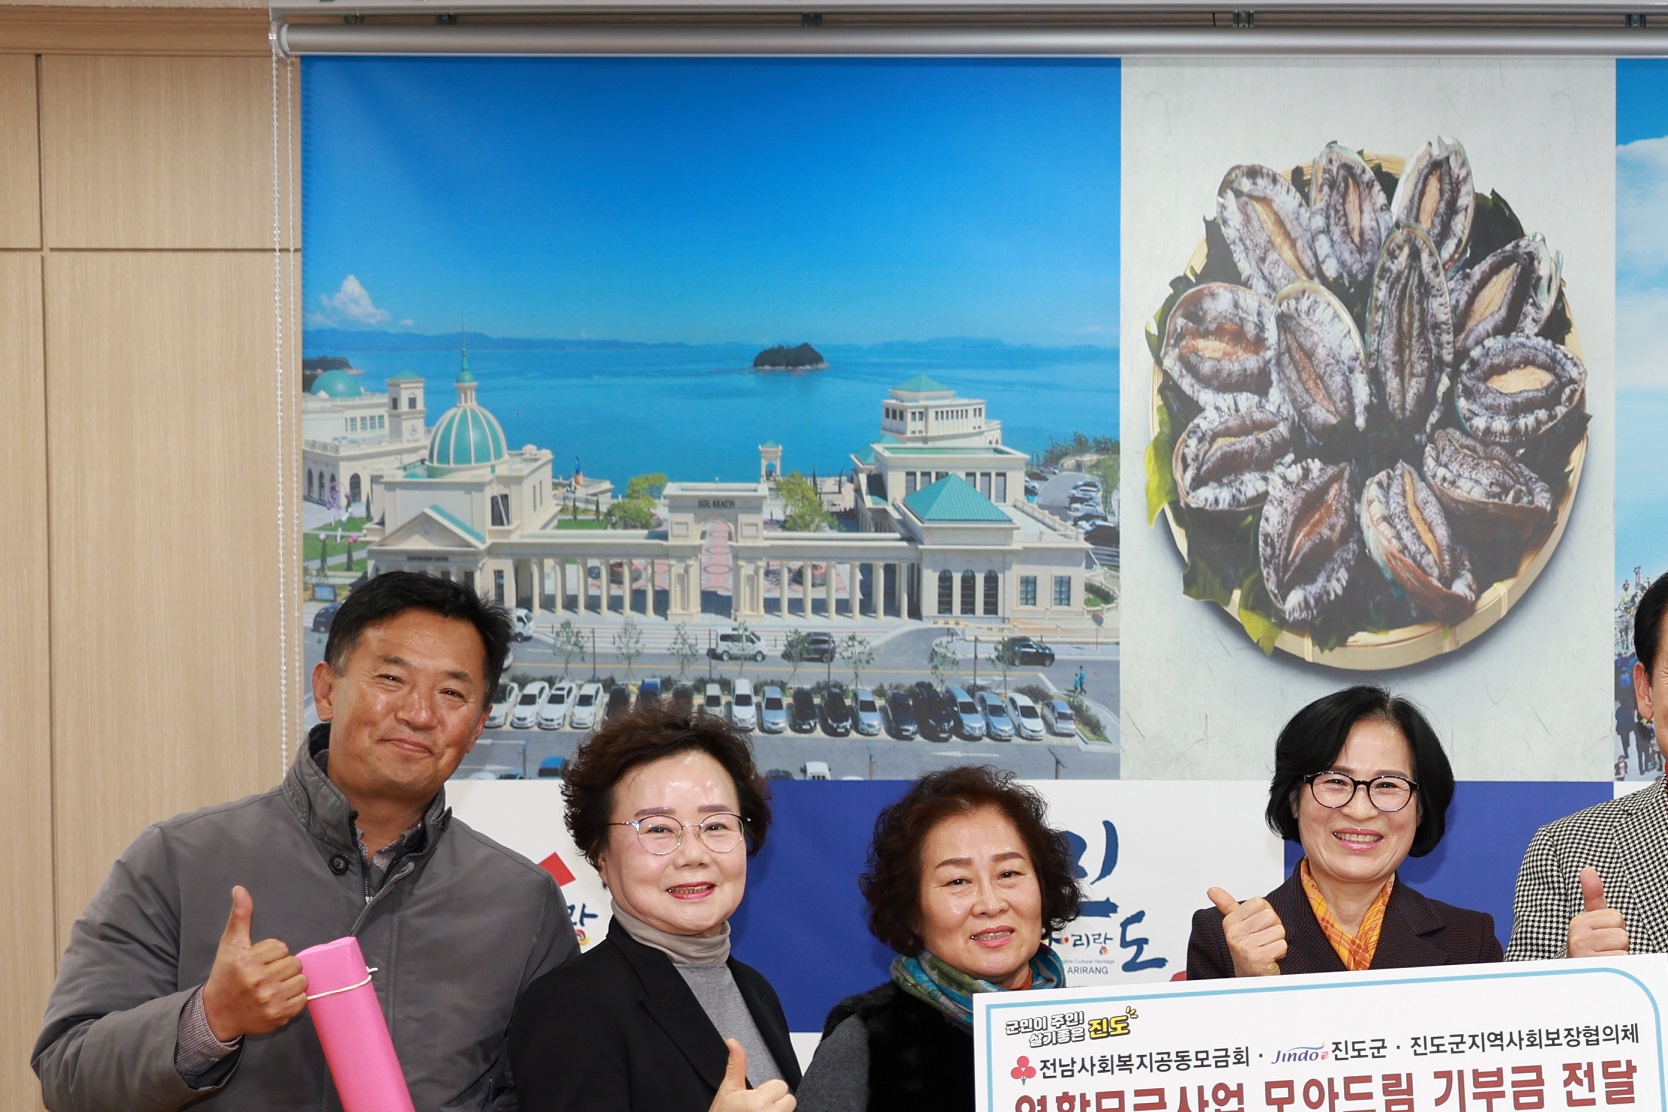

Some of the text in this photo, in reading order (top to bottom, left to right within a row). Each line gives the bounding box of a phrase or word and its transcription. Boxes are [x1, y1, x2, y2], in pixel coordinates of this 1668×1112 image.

[1067, 966, 1109, 975] ARIRANG
[1005, 1010, 1085, 1036] 군민이 주인!
[1028, 1014, 1132, 1048] 살기좋은 진도
[1038, 1022, 1640, 1080] 전남사회복지공동모금회 Jindo 진도군 진도군지역사회보장협의체
[1562, 1059, 1638, 1108] 전달
